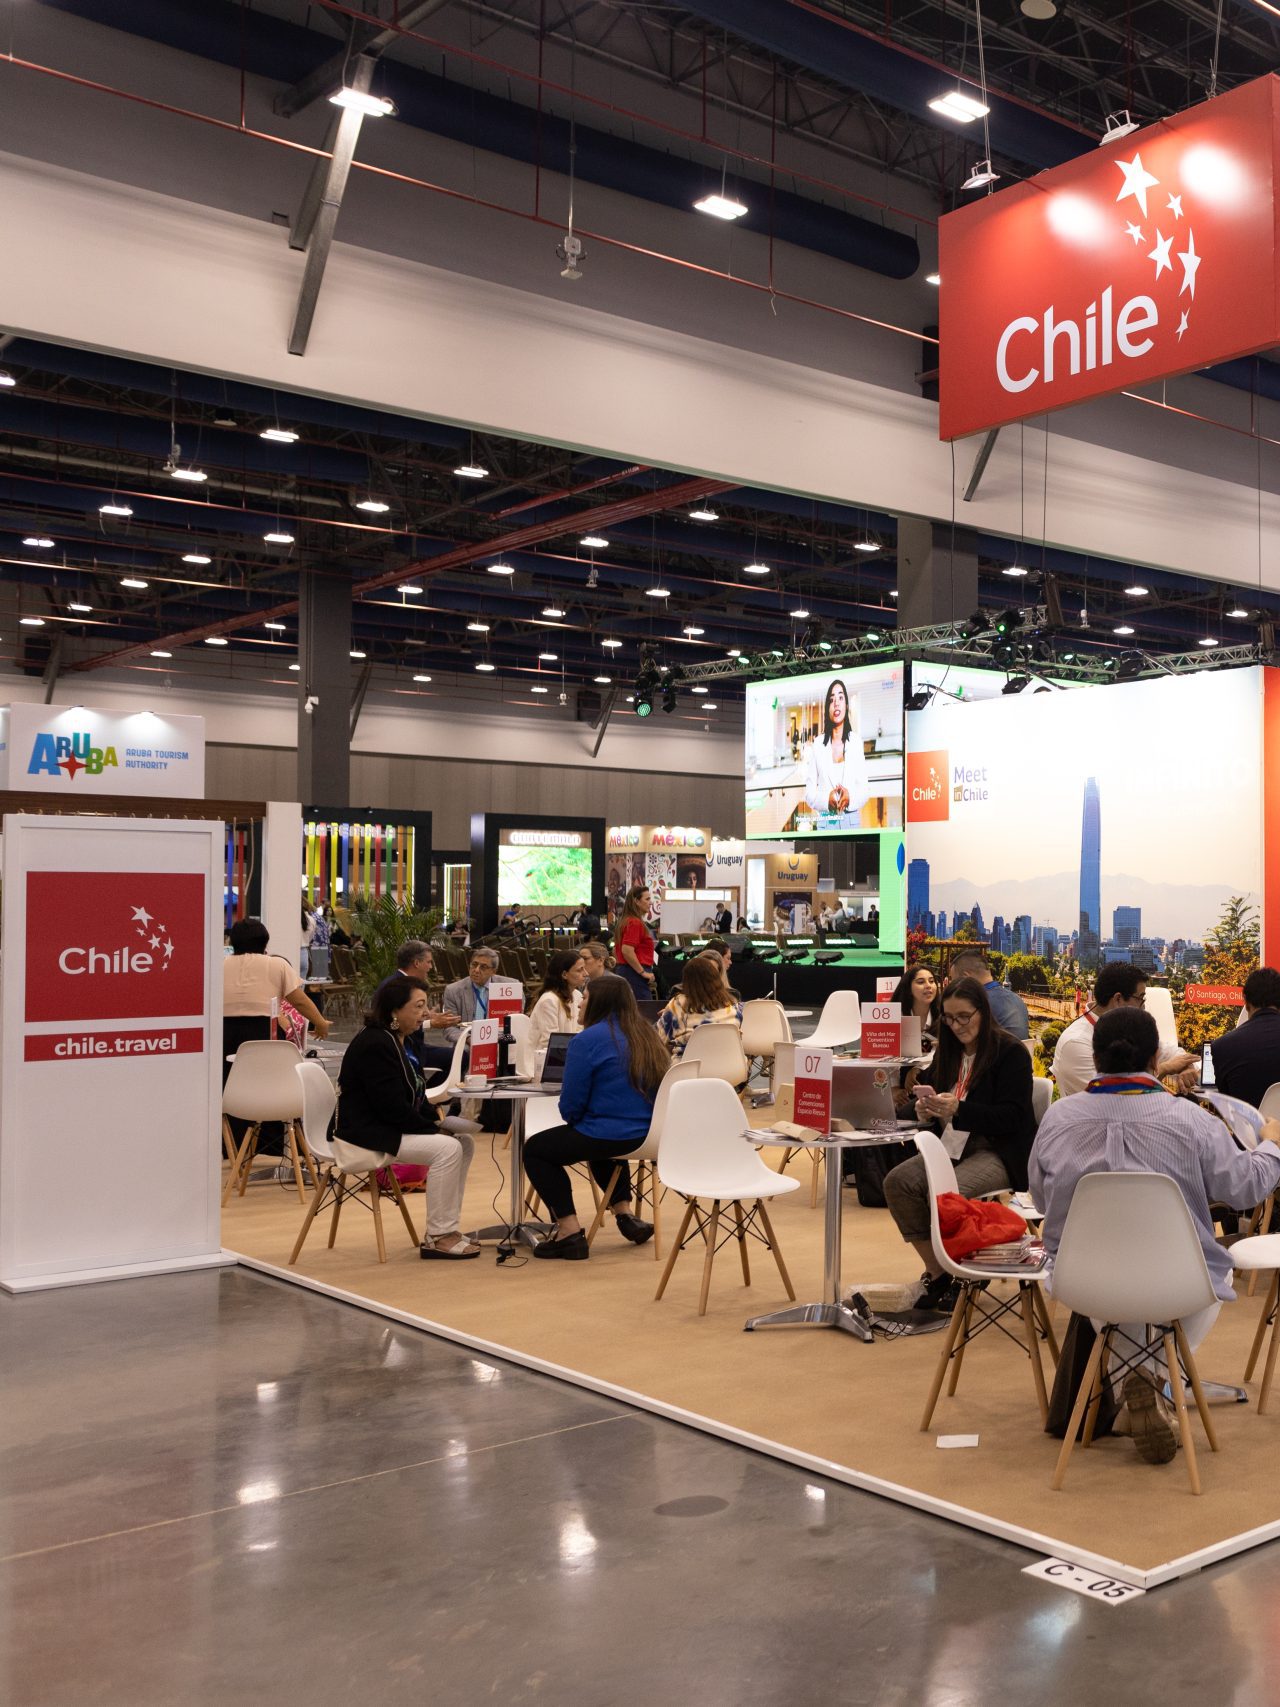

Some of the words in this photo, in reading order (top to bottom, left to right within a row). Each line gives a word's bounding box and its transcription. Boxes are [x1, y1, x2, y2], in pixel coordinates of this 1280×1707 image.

[996, 284, 1159, 393] Chile
[27, 732, 119, 776] ARUBA
[125, 748, 152, 758] ARUBA
[155, 750, 189, 760] TOURISM
[125, 760, 168, 770] AUTHORITY
[954, 766, 988, 783] Meet
[912, 787, 936, 801] Chile
[304, 823, 396, 839] UATEMALA
[652, 829, 705, 848] México
[716, 855, 744, 866] Uruguay
[777, 871, 809, 882] Uruguay
[58, 946, 154, 975] Chile
[499, 986, 513, 997] 16
[885, 981, 893, 991] 11
[1196, 990, 1228, 1001] Santiago,
[1229, 991, 1245, 1000] Chil
[872, 1007, 891, 1020] 08
[479, 1025, 492, 1041] 09
[54, 1033, 178, 1056] chile.travel
[805, 1055, 821, 1073] 07
